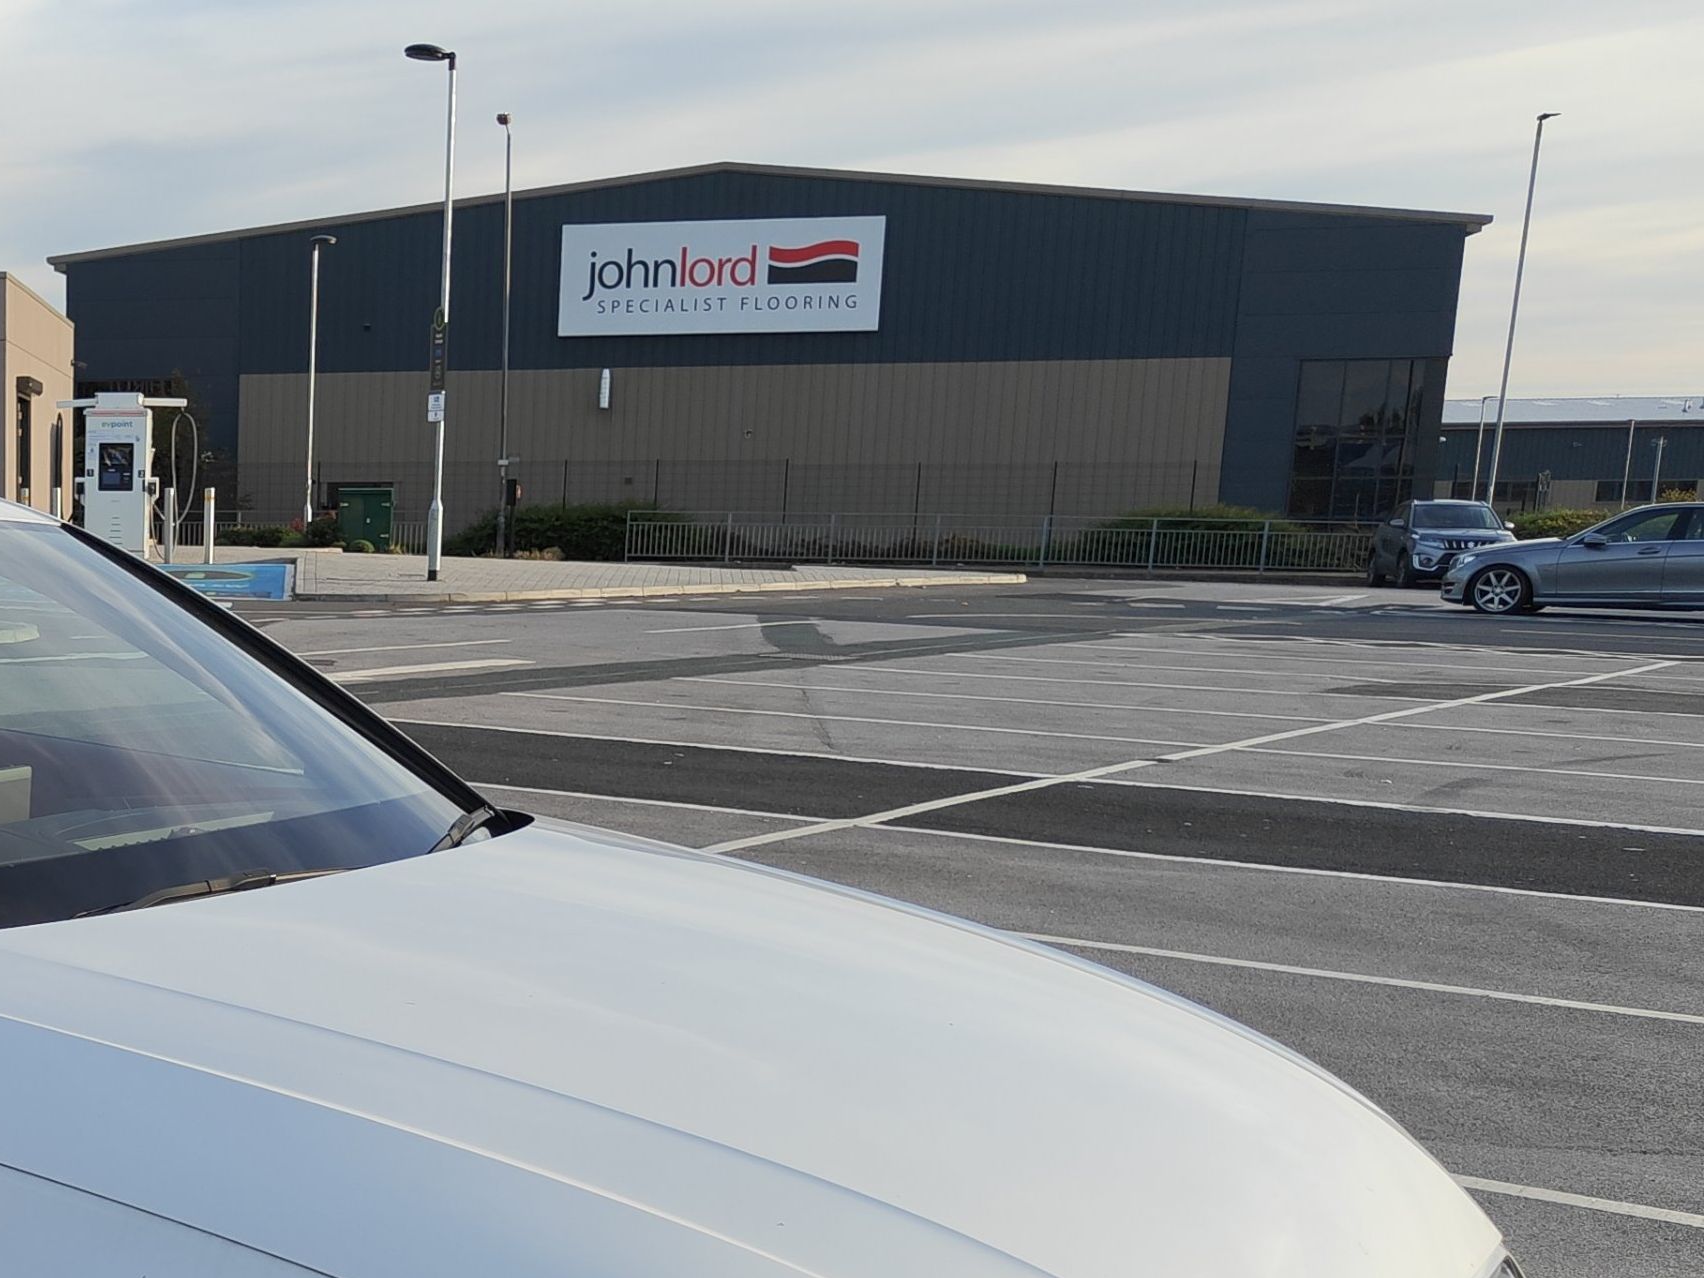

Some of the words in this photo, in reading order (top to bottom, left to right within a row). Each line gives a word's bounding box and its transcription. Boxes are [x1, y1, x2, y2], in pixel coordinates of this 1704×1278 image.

[582, 244, 758, 301] johnlord
[597, 297, 728, 314] SPECIALIST
[740, 294, 859, 311] FLOORING
